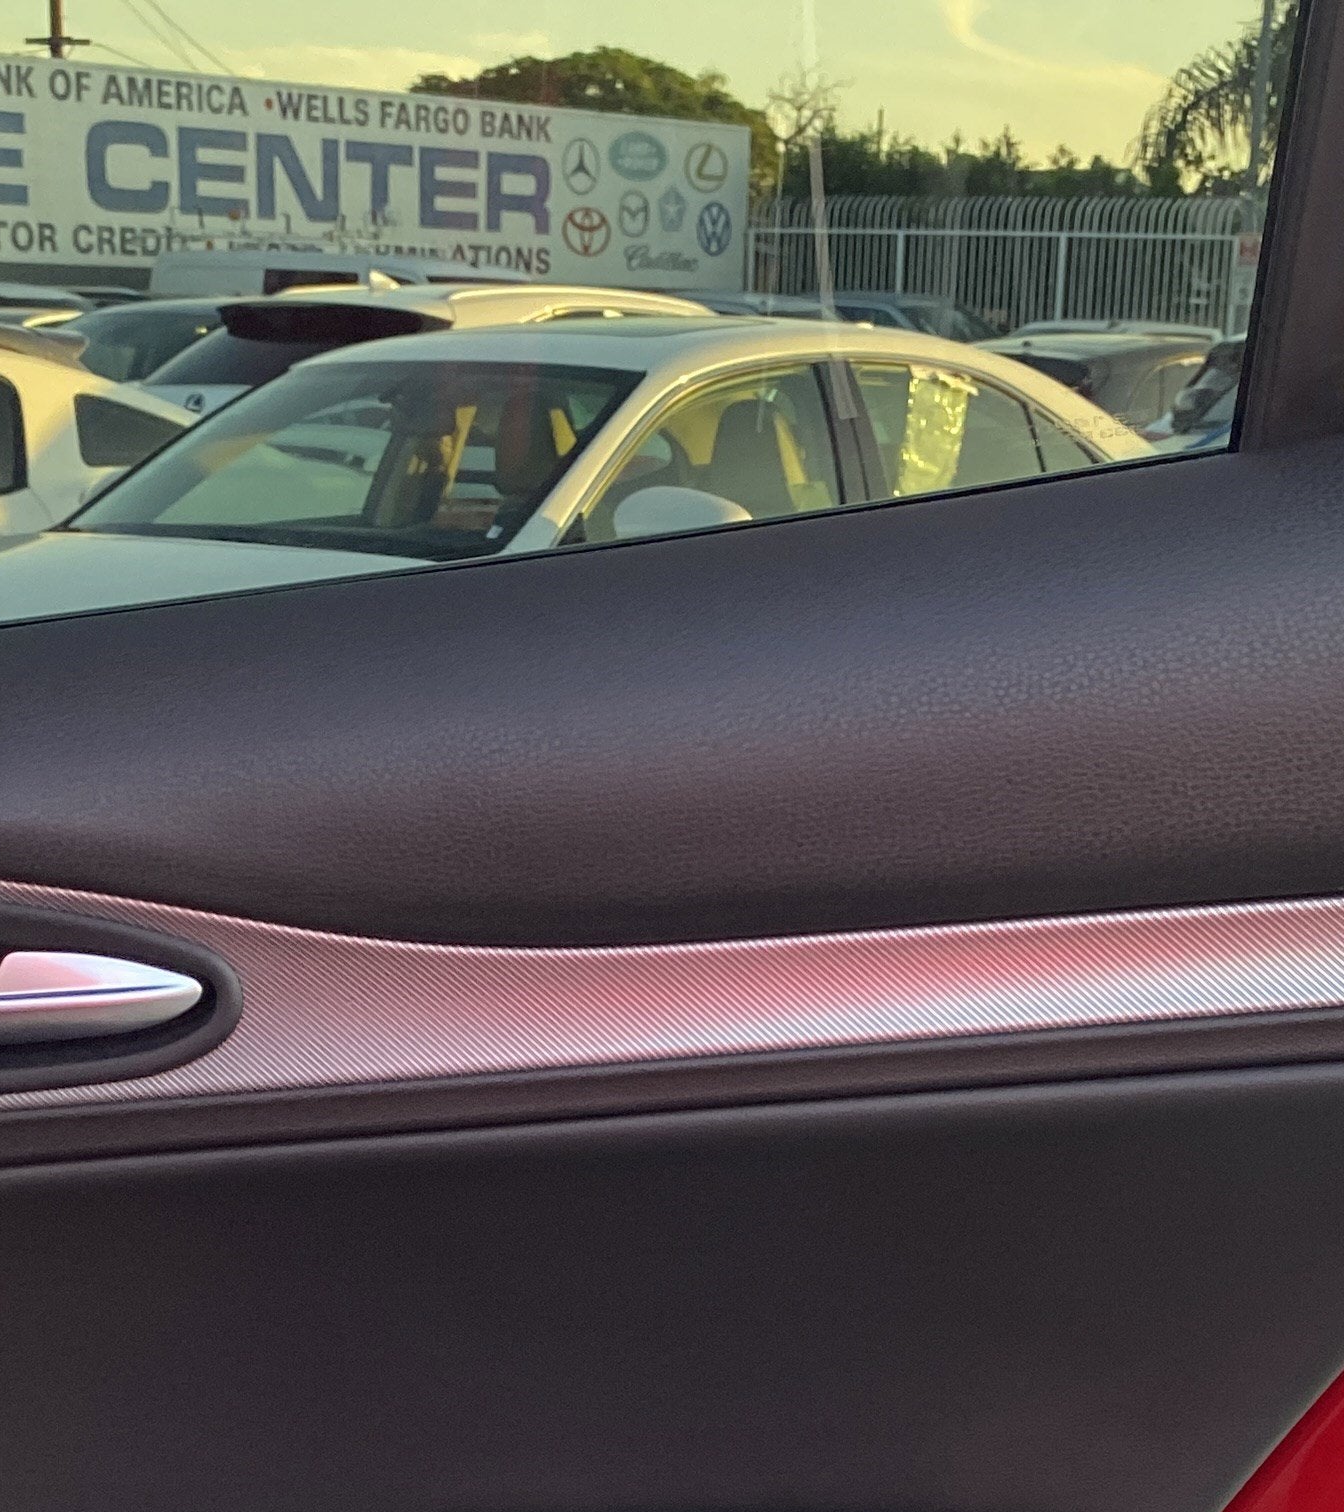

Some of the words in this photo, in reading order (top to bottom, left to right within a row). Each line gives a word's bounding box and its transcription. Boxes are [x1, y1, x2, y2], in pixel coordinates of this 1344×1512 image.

[49, 68, 92, 102] OF
[102, 74, 250, 117] AMERICA
[276, 90, 369, 127] WELLS
[379, 100, 471, 137] FARGO
[480, 110, 552, 143] BANK
[85, 119, 551, 235] CENTER
